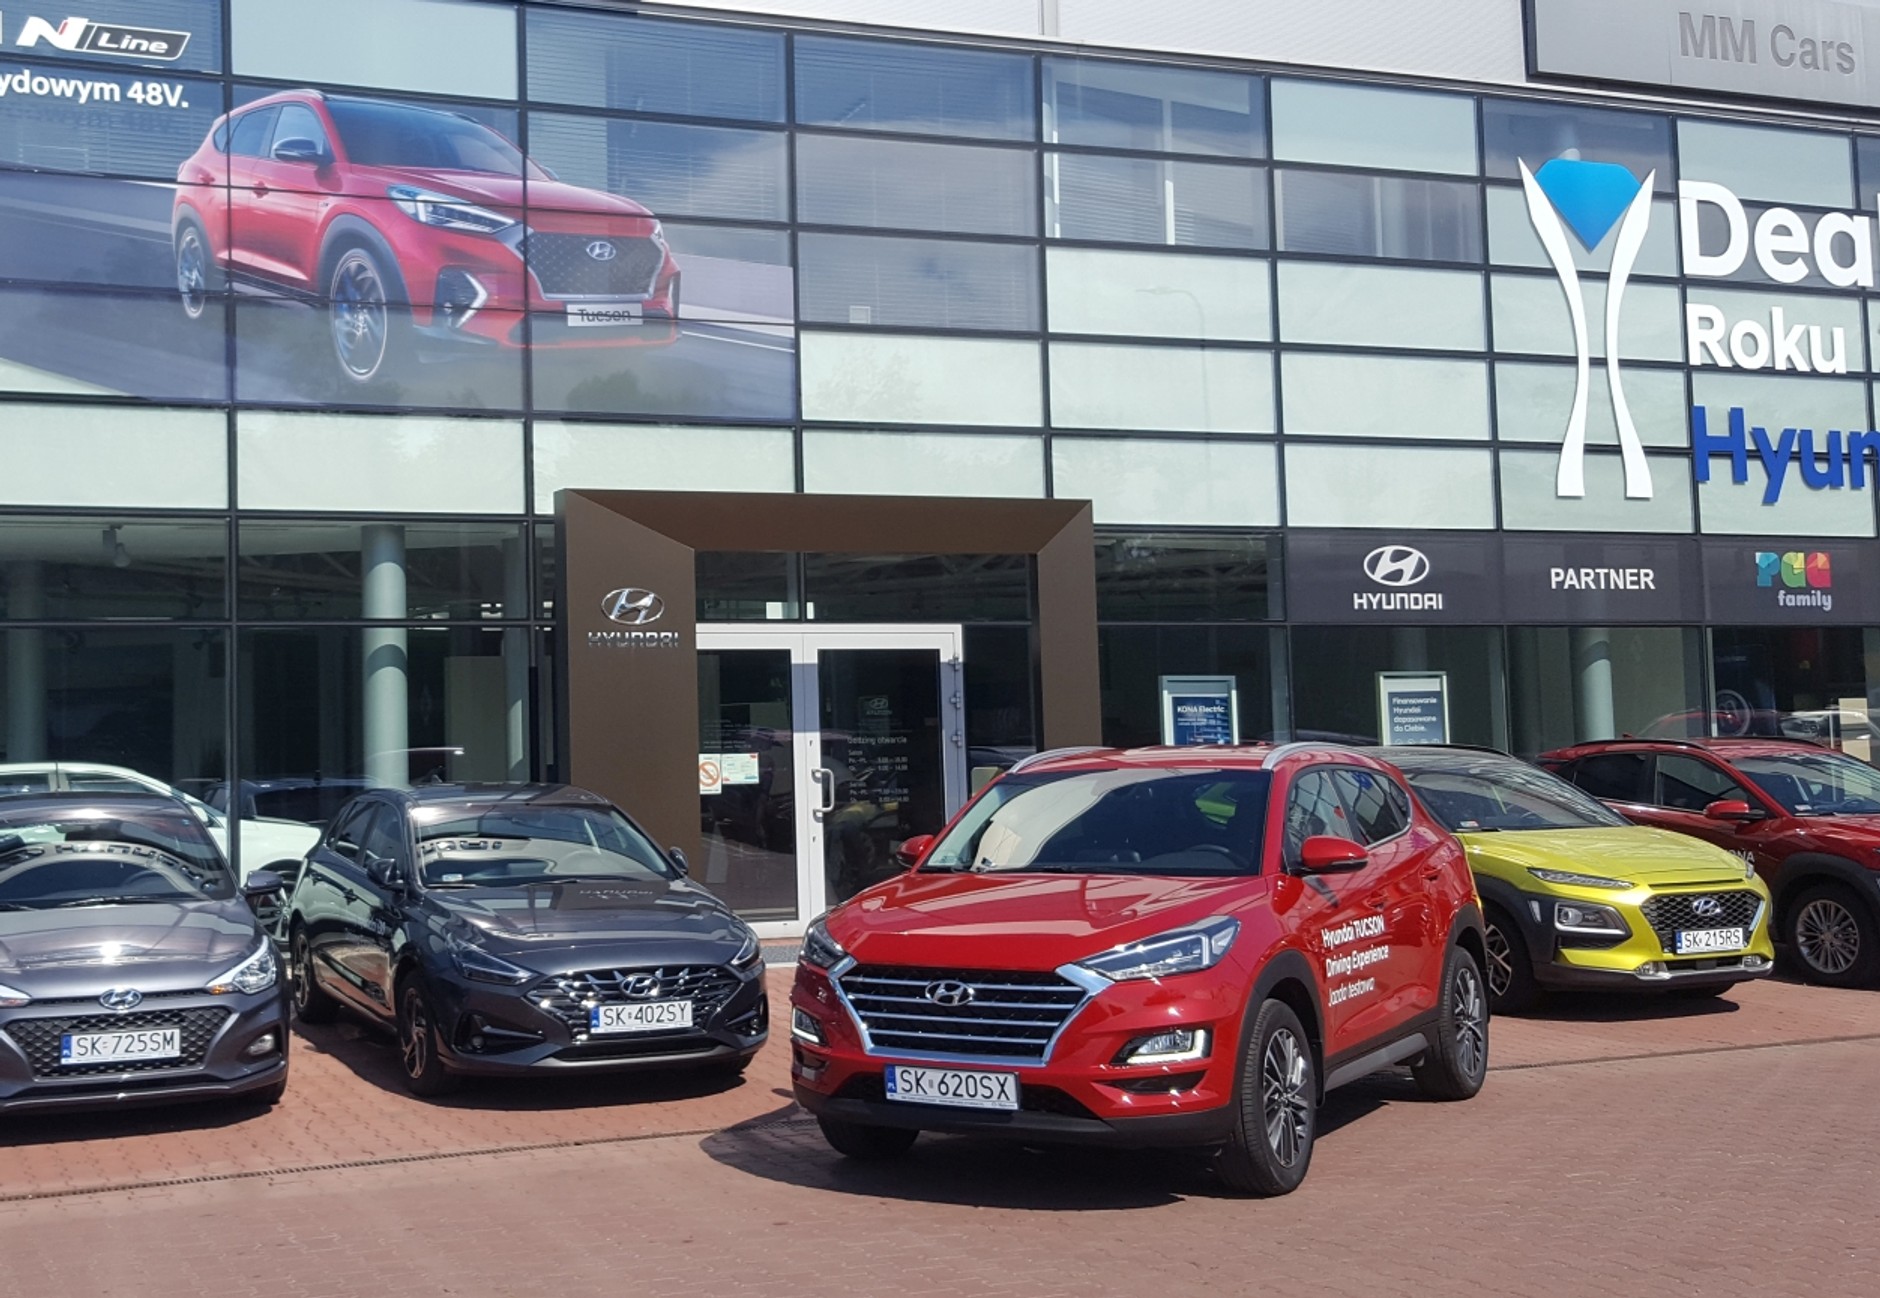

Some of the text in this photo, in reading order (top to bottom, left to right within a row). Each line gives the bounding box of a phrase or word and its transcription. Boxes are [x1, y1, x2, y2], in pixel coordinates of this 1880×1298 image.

[97, 31, 169, 54] Line
[1679, 12, 1856, 75] MM Cars
[127, 81, 190, 109] 48V.
[1678, 180, 1880, 287] Dea
[577, 309, 631, 322] Tucson
[1685, 302, 1847, 374] Roku
[1550, 567, 1656, 590] PARTNER
[1352, 592, 1443, 611] HYUNDAI
[1777, 590, 1832, 611] family
[588, 631, 679, 648] HYUNDAI
[1177, 705, 1225, 713] KONA Electric
[1321, 914, 1385, 950] Hyundai TUCSON
[1684, 929, 1740, 949] SK 215RS
[1325, 944, 1389, 978] Driving Experience
[604, 1003, 688, 1026] SK 402SY
[76, 1031, 175, 1056] SK 725SM
[900, 1069, 928, 1096] SK
[937, 1073, 1011, 1102] 620SX
